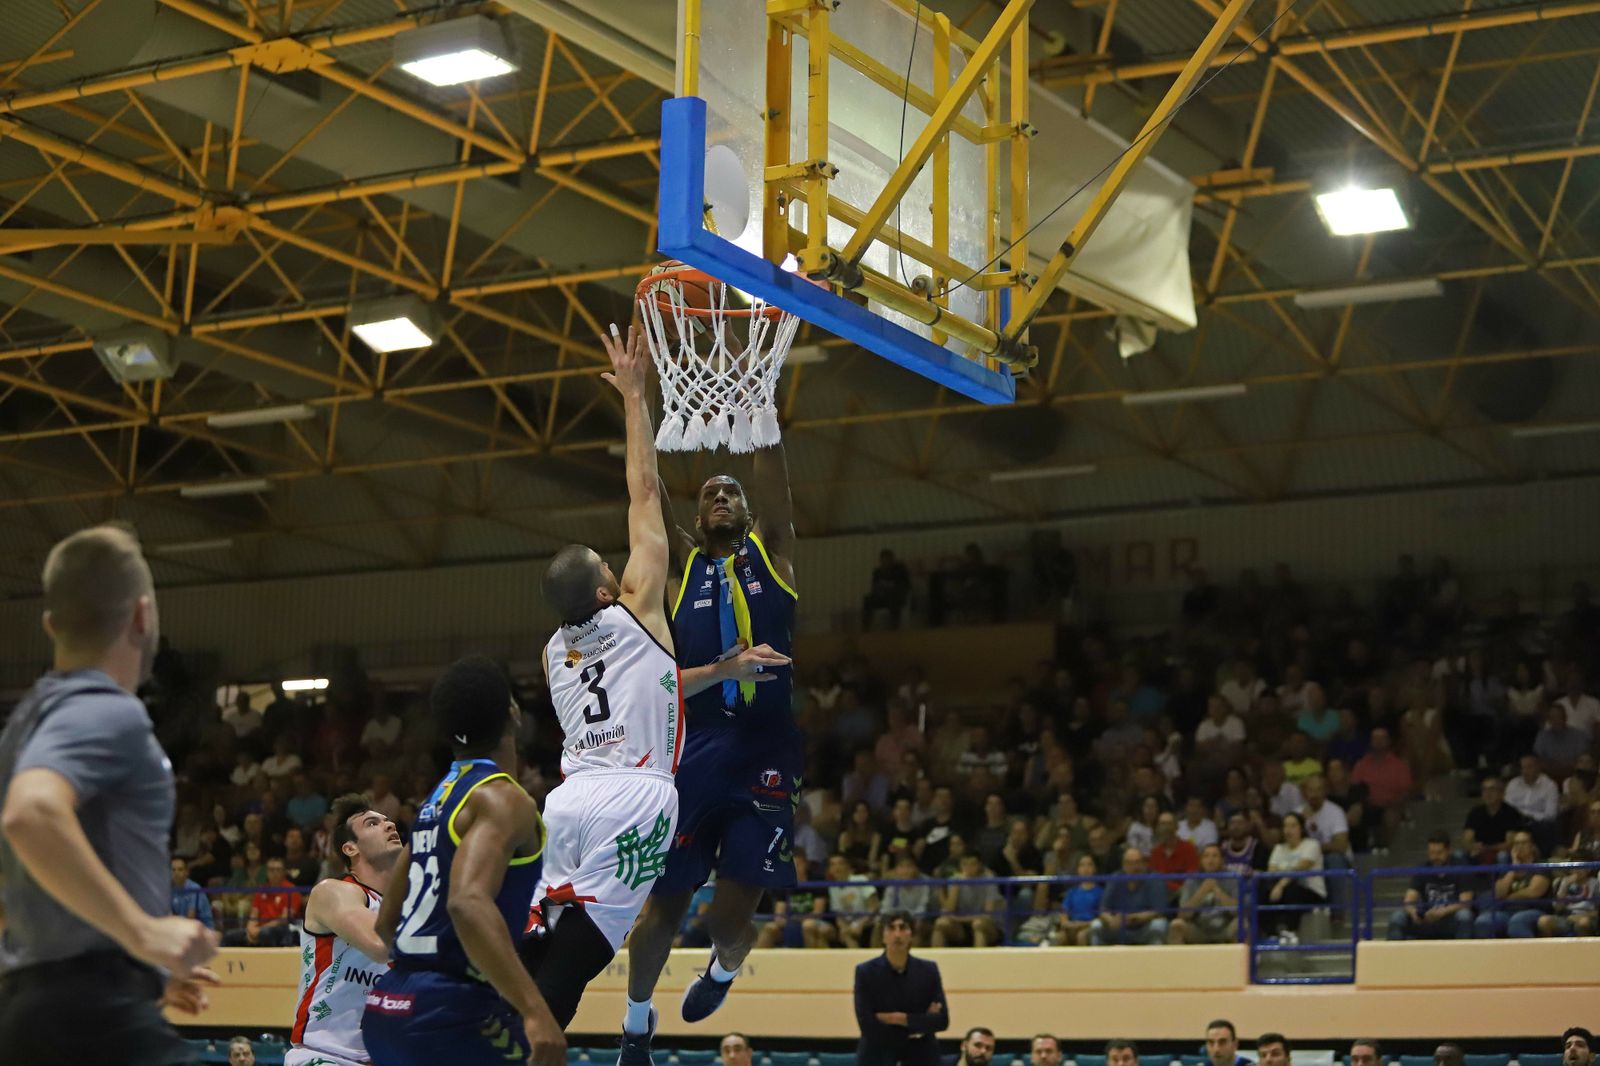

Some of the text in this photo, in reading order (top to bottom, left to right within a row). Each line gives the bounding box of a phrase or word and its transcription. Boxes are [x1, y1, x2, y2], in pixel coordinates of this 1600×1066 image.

[580, 659, 611, 725] 3
[586, 724, 625, 748] Opinión
[666, 727, 675, 756] RURAL
